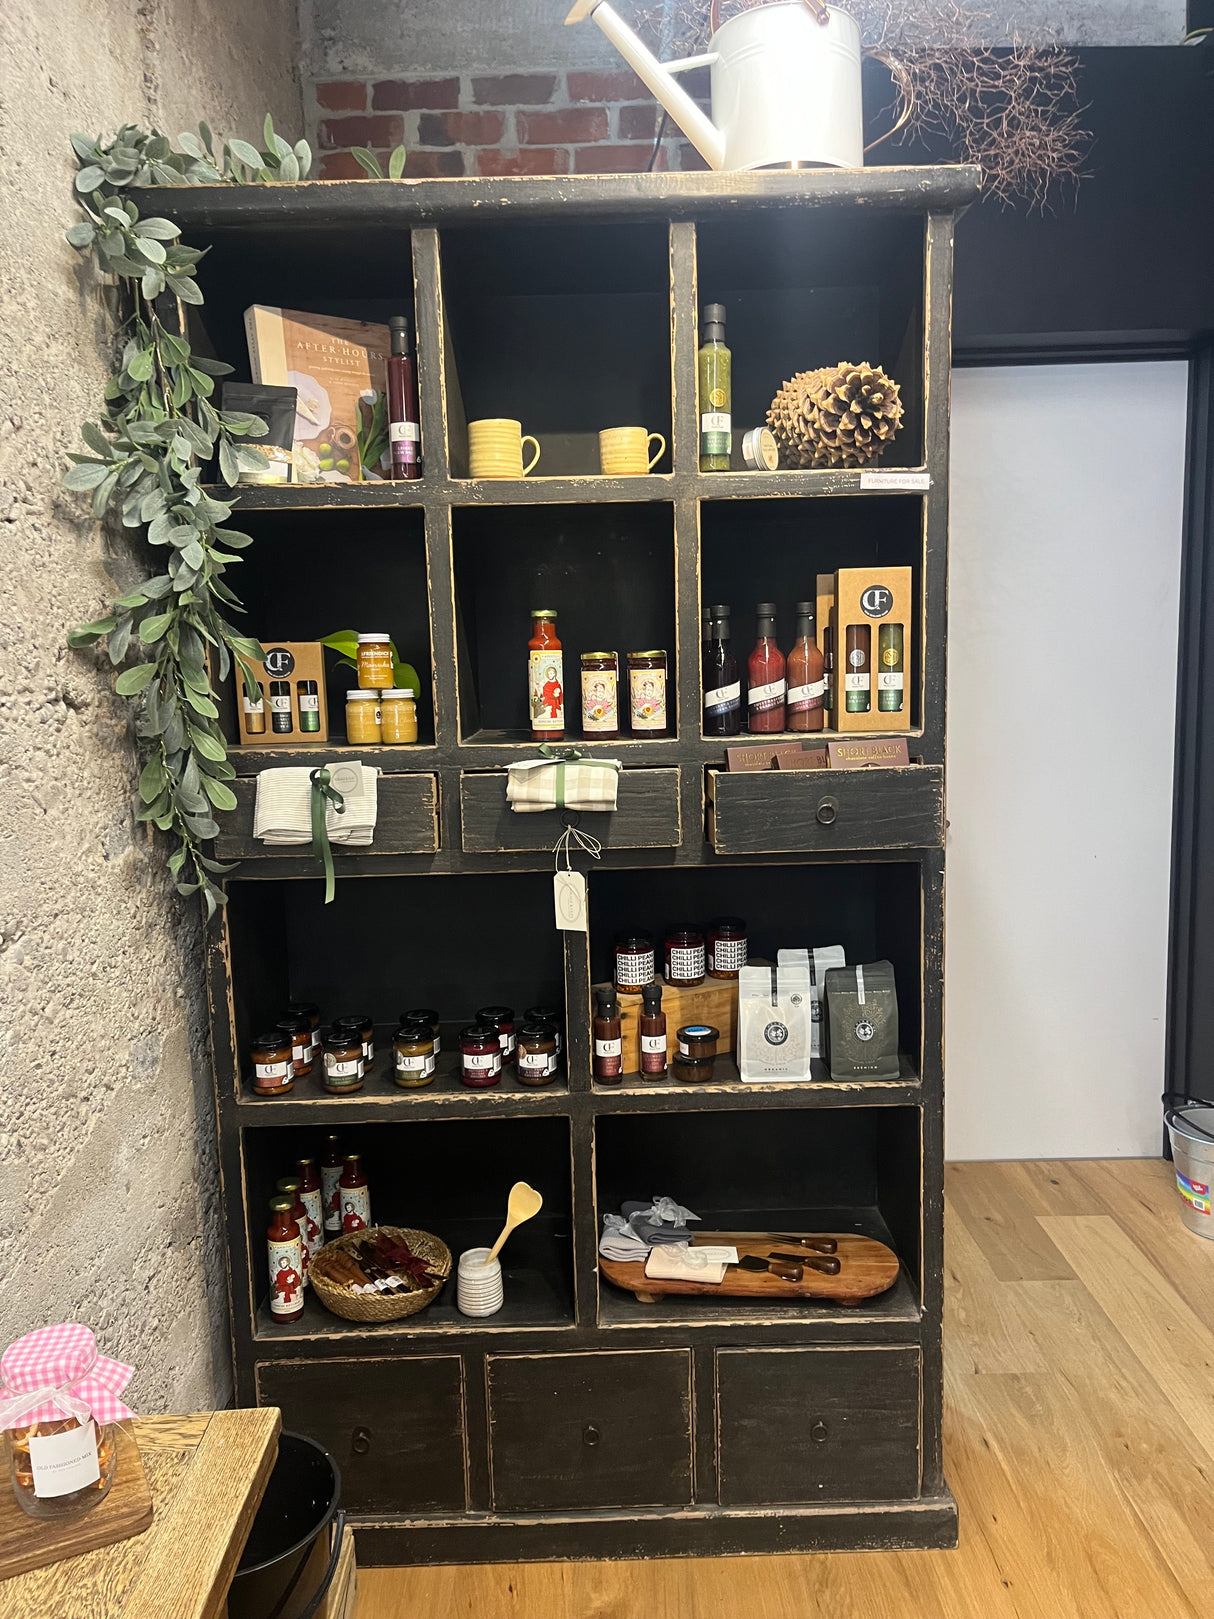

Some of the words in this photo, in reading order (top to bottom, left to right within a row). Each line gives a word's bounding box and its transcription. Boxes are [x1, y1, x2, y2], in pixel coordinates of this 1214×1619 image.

[323, 356, 360, 367] STYLIST
[837, 746, 869, 757] SHORT
[872, 745, 902, 755] BLACK
[49, 1456, 81, 1470] FASHIONED
